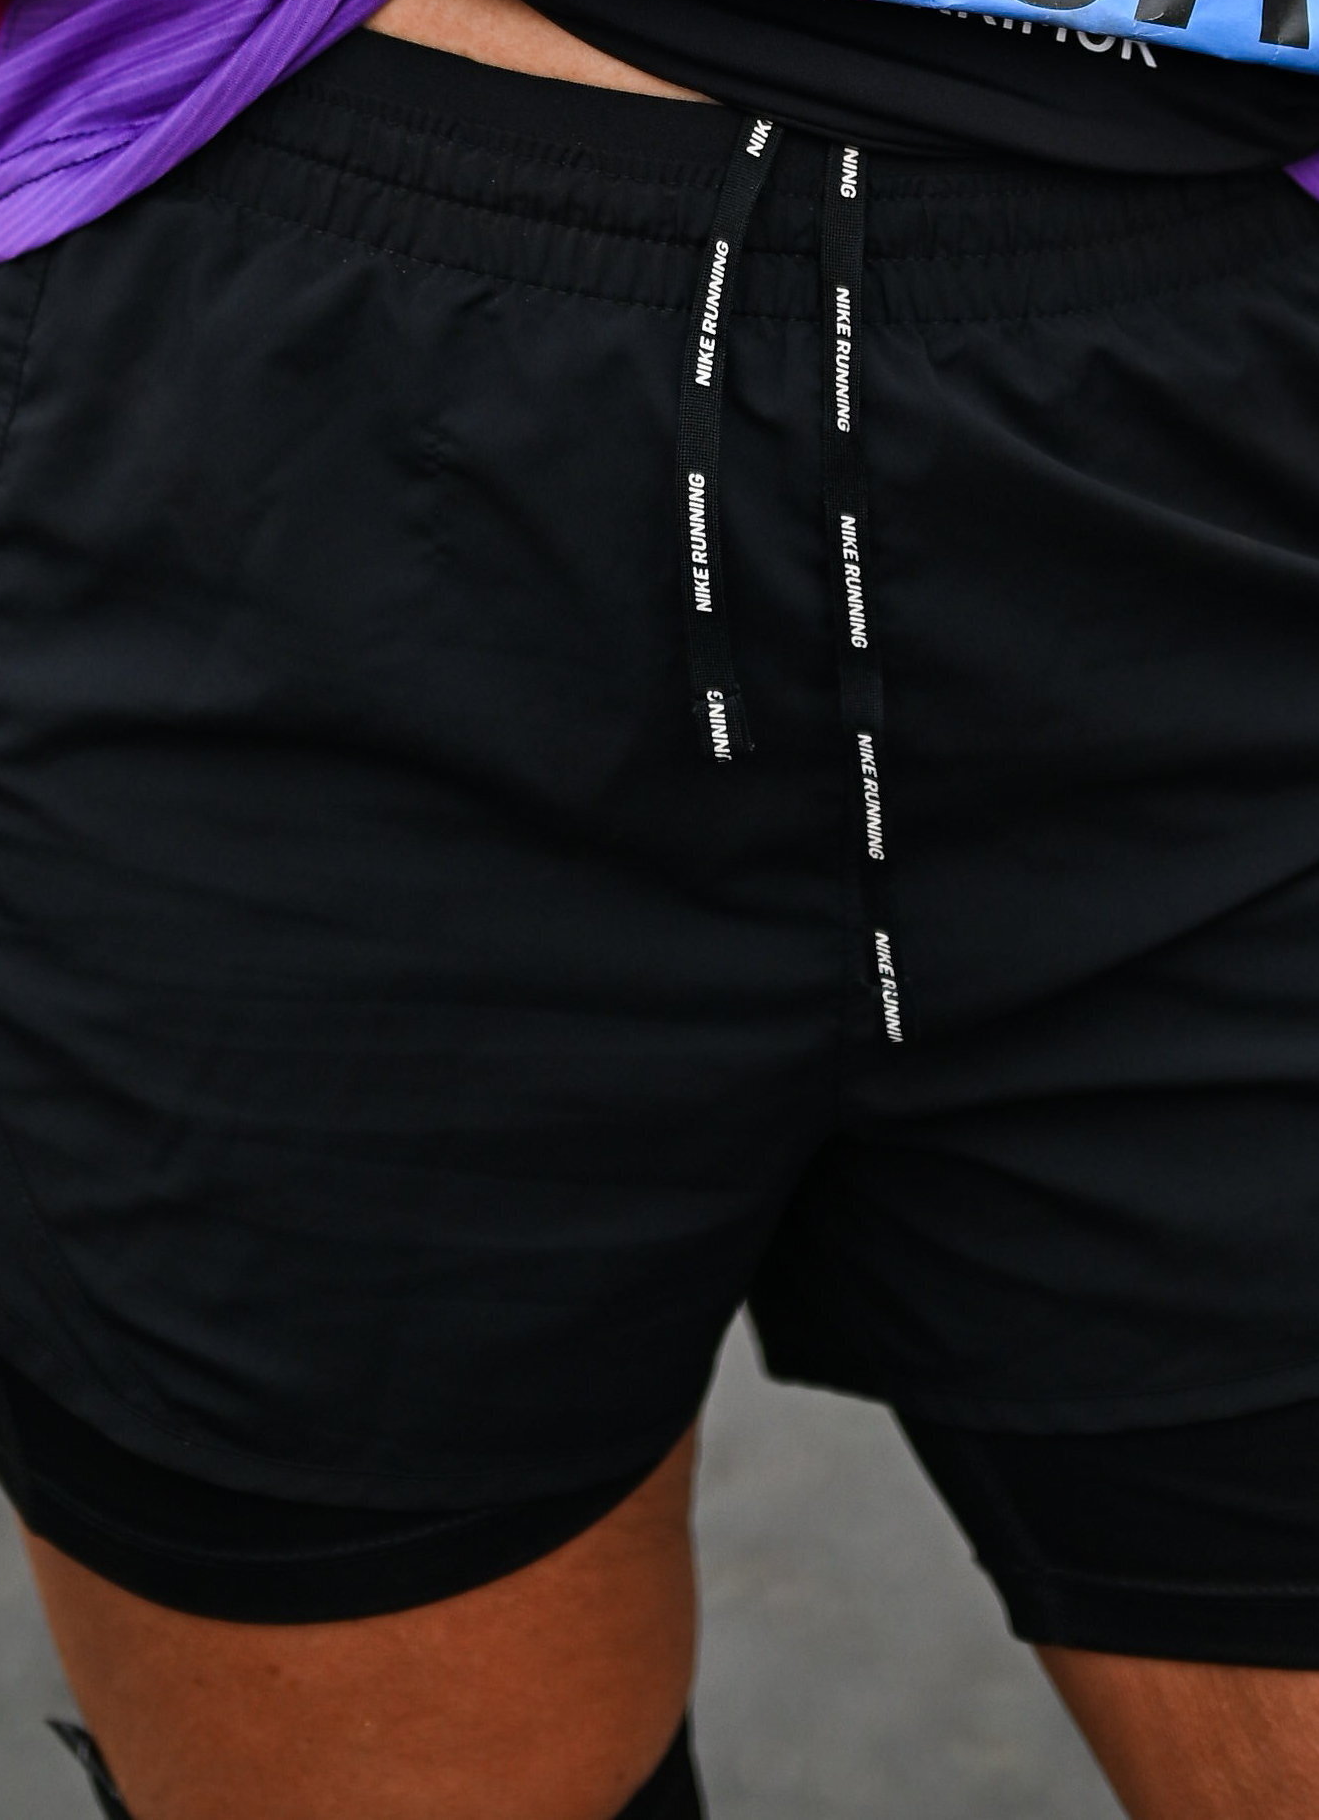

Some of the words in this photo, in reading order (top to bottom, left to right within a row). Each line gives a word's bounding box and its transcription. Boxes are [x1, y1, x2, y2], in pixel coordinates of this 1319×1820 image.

[745, 118, 774, 158] NIK
[839, 145, 860, 199] NING
[702, 239, 730, 335] RUNNING
[835, 286, 852, 335] NIKE
[694, 335, 716, 387] NIKE
[835, 338, 852, 433] RUNNING
[688, 471, 708, 565] RUNNING
[840, 514, 860, 562] NIKE
[692, 566, 713, 613] NIKE
[843, 562, 869, 649] RUNNING
[857, 733, 878, 778] NIKE
[862, 777, 885, 861] RUNNING
[874, 931, 896, 978] NIKE
